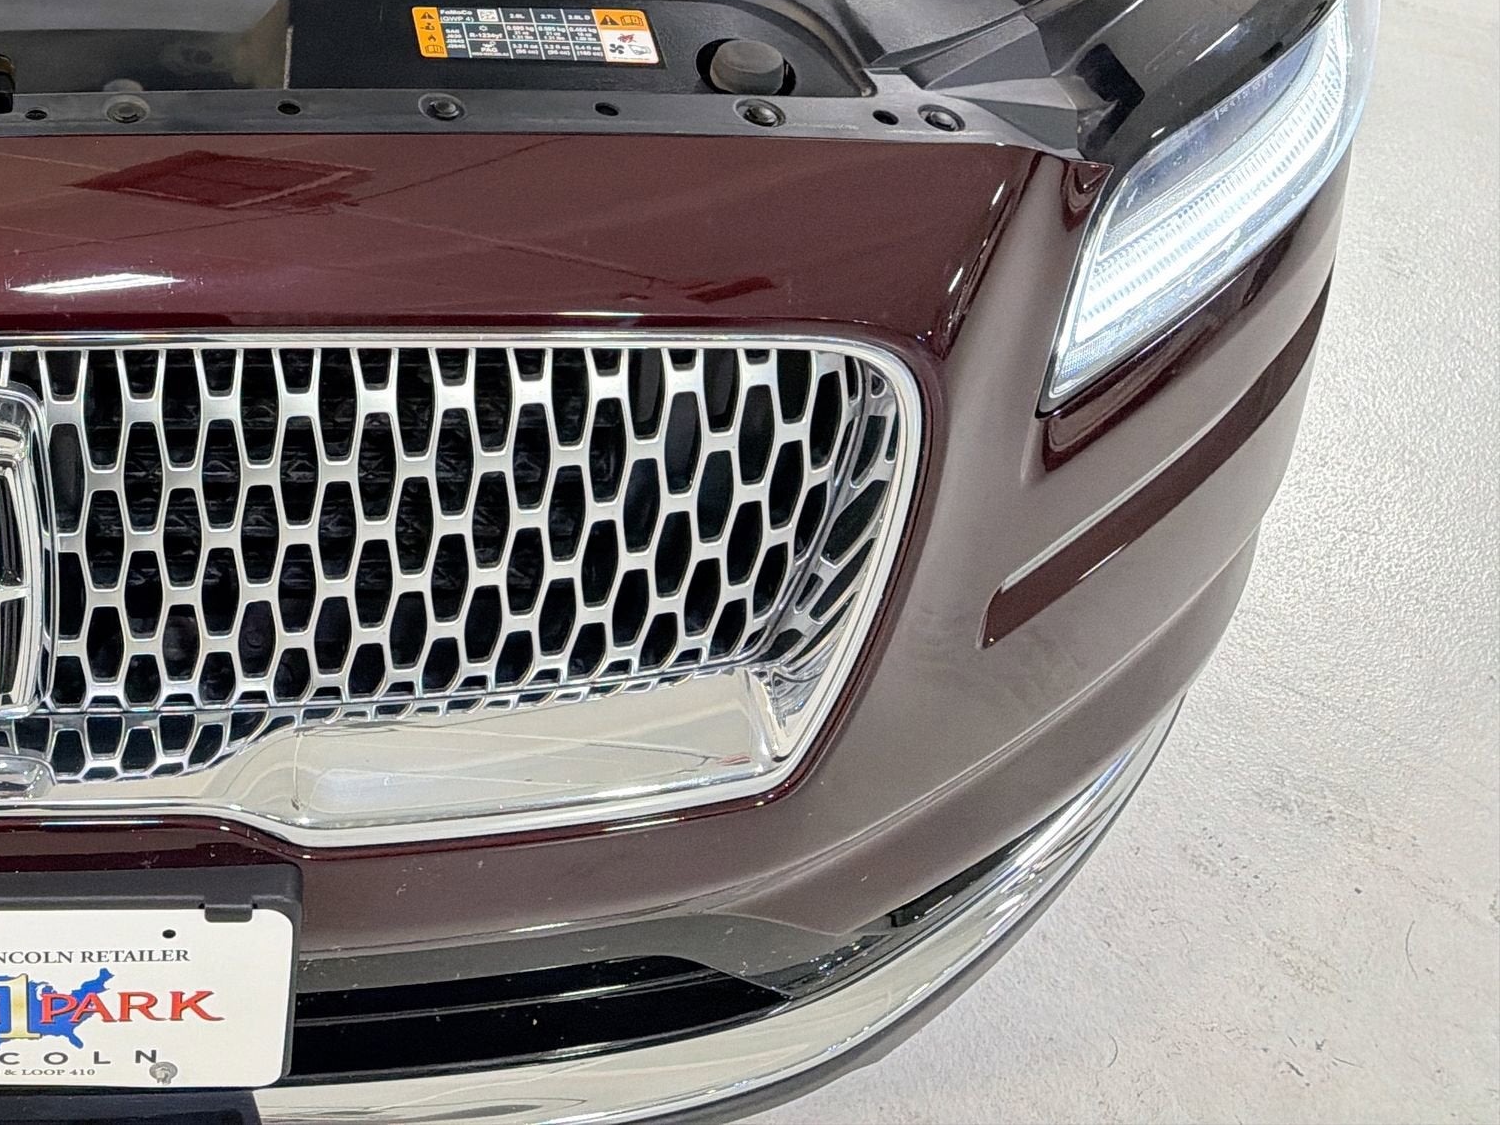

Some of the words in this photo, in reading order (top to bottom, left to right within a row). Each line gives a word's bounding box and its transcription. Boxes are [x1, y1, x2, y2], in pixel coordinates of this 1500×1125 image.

[79, 948, 191, 964] RETAILER
[40, 990, 225, 1025] PARK
[3, 1068, 18, 1076] &
[69, 1068, 96, 1076] 410
